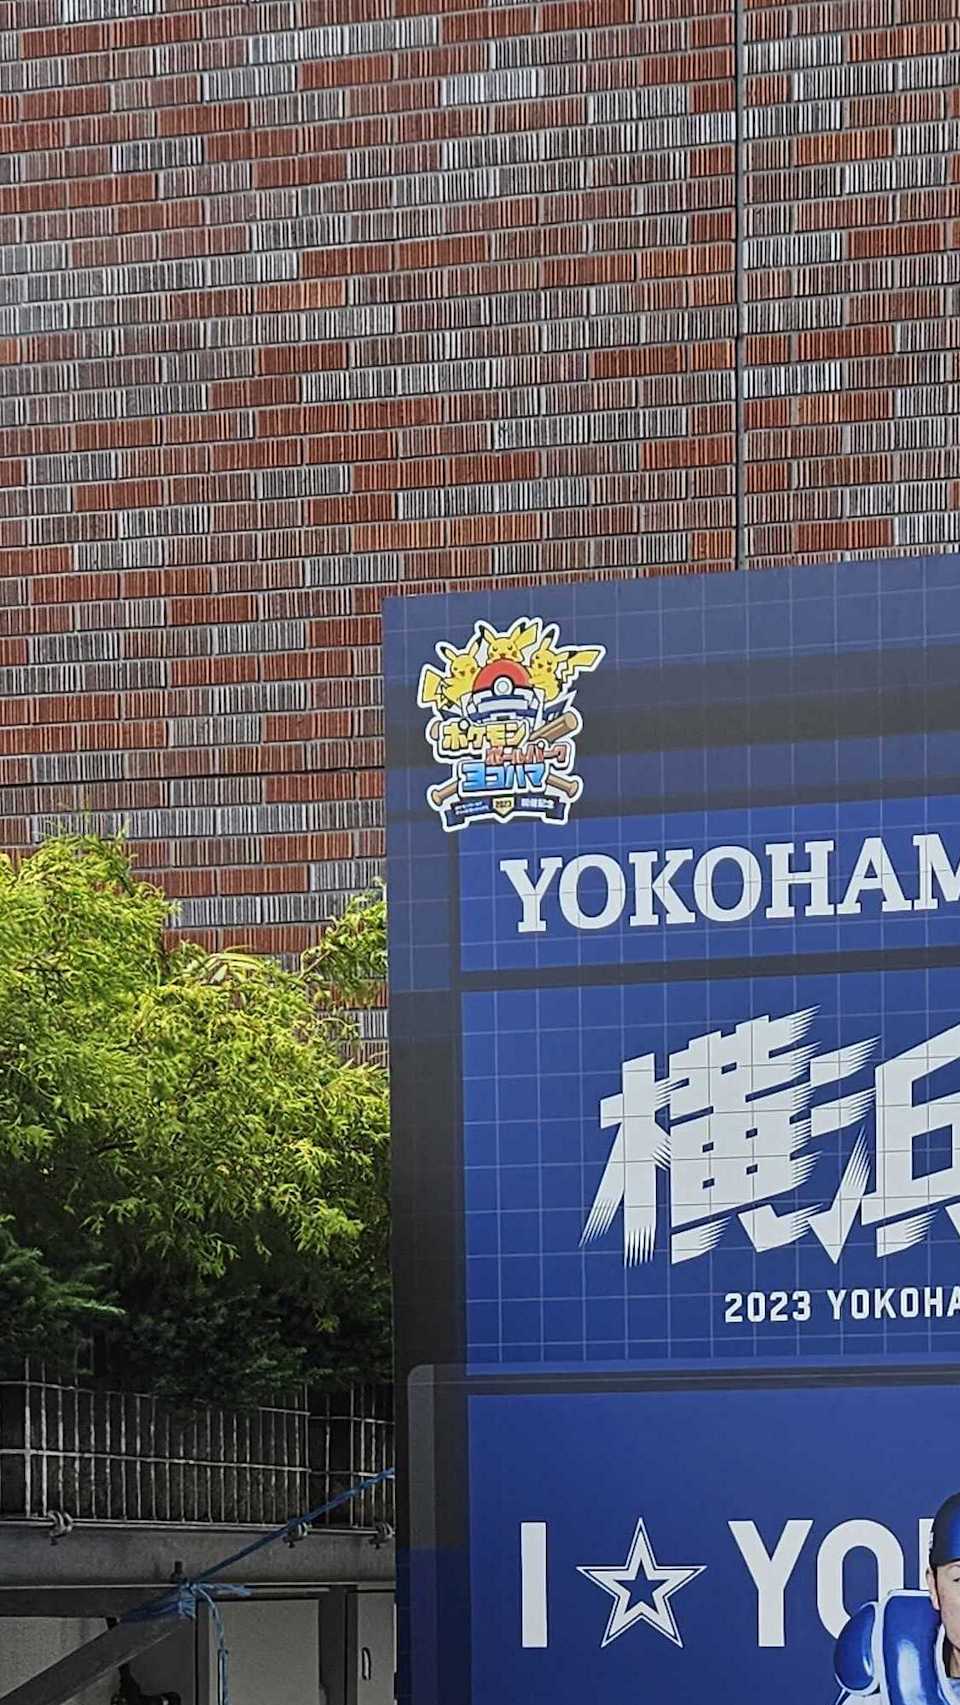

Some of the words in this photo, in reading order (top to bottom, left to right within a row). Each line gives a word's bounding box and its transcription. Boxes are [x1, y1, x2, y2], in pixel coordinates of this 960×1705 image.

[442, 721, 526, 750] ポケモン
[462, 763, 546, 791] ヨコハマ
[725, 1290, 811, 1323] 2023
[520, 1521, 548, 1648] I
